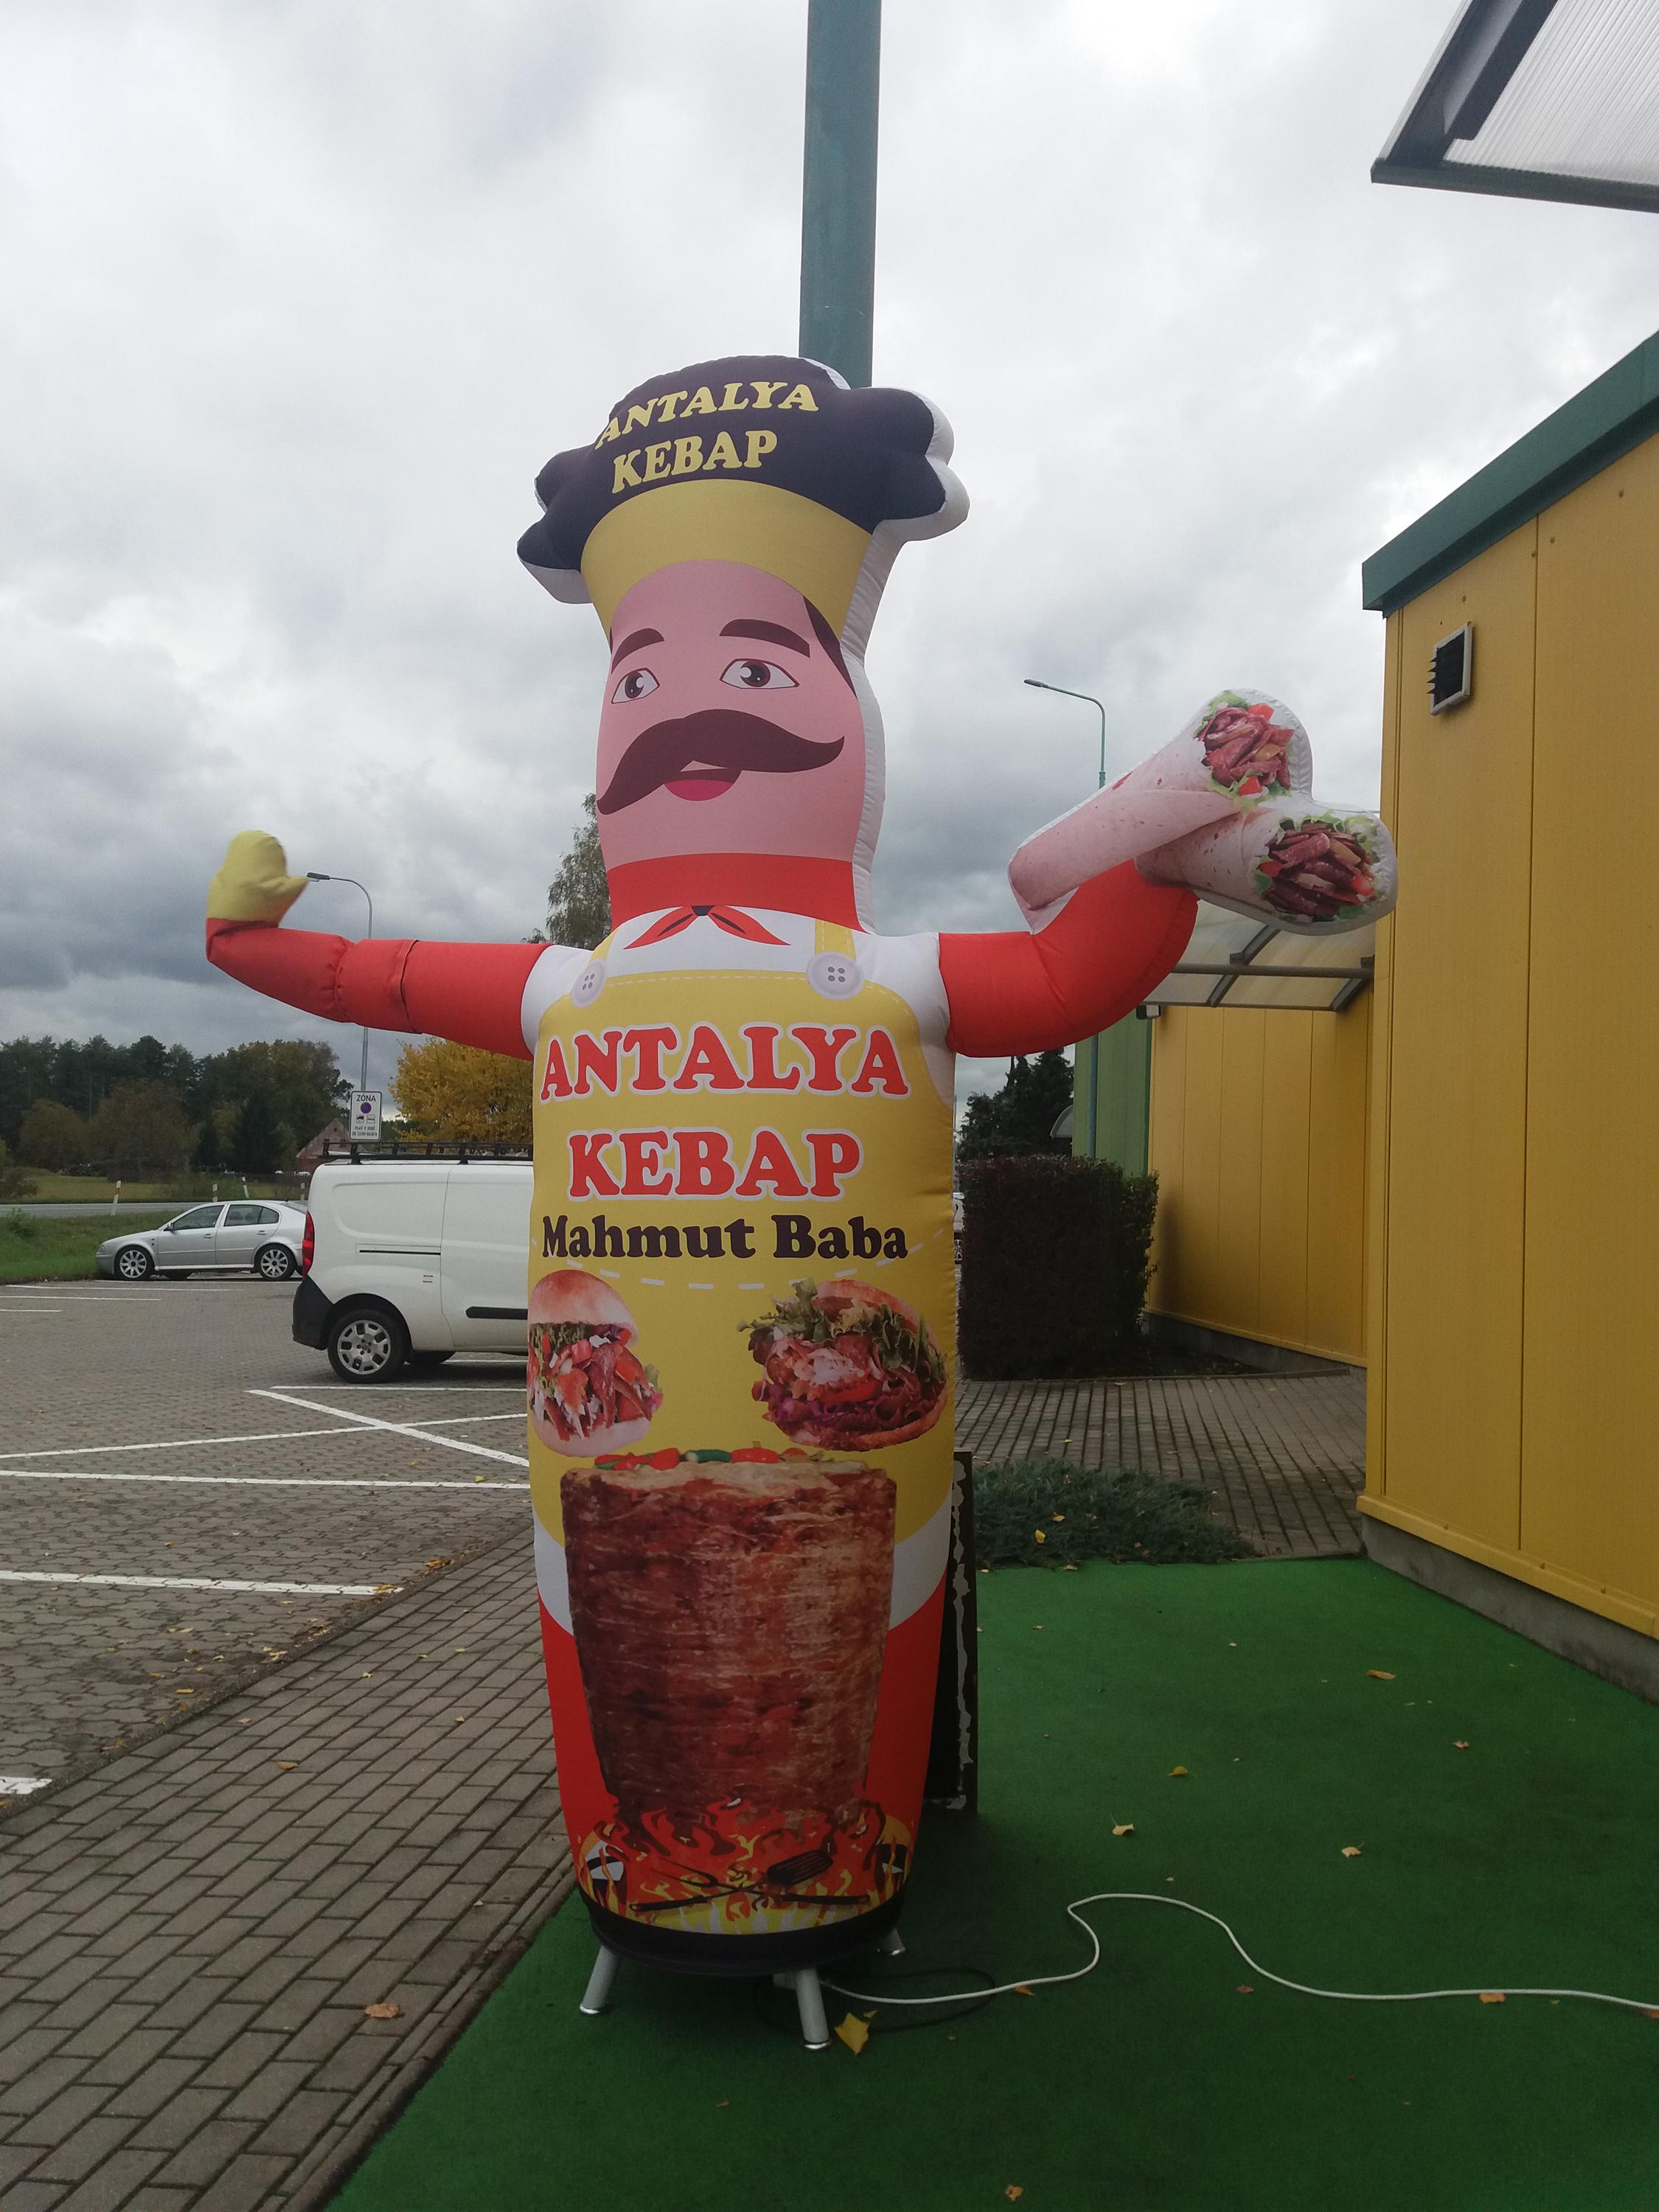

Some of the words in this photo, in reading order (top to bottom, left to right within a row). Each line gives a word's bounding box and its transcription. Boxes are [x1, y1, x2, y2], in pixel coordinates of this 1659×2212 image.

[595, 381, 819, 450] ANTALYA
[611, 430, 778, 494] KEBAP
[539, 1023, 911, 1102] ANTALYA
[356, 1093, 376, 1102] ZÓNA
[568, 1128, 862, 1199] KEBAP
[542, 1214, 756, 1259] Mahmut
[771, 1214, 909, 1259] Baba
